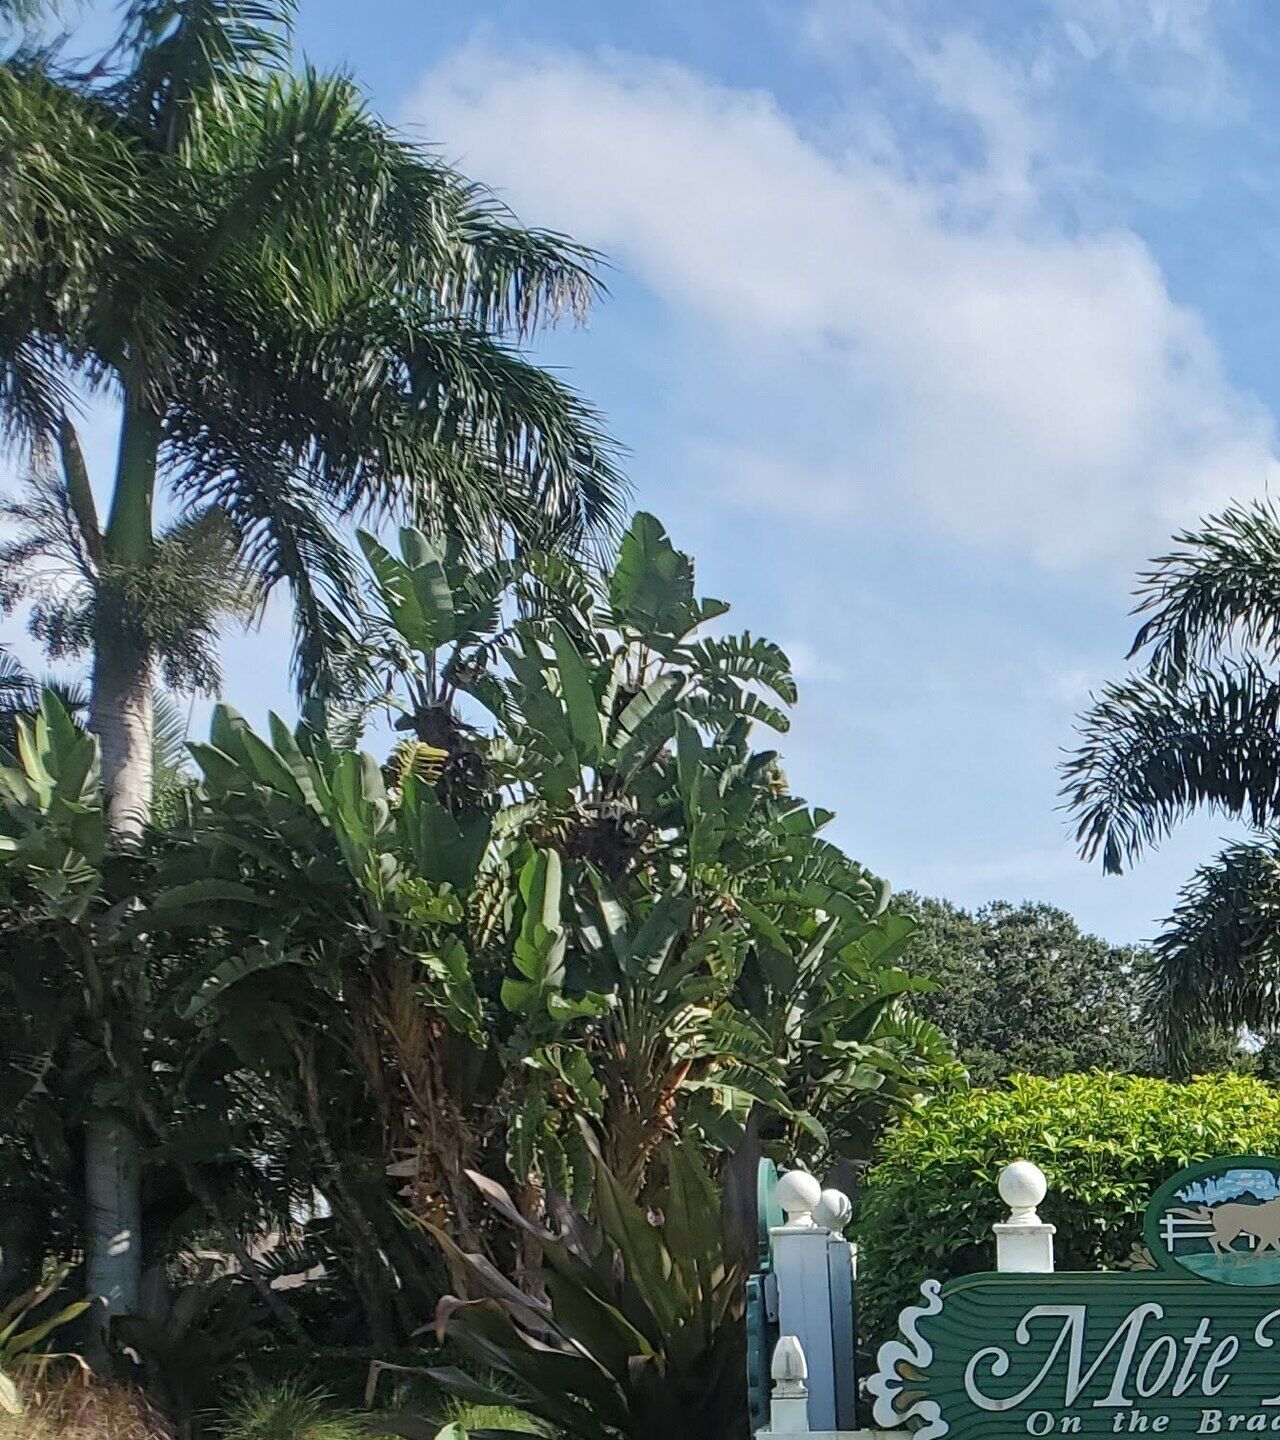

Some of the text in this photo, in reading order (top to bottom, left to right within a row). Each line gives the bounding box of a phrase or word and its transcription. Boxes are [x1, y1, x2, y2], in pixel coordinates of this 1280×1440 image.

[964, 1302, 1241, 1410] Mote
[1026, 1410, 1082, 1434] On
[1113, 1410, 1169, 1434] the
